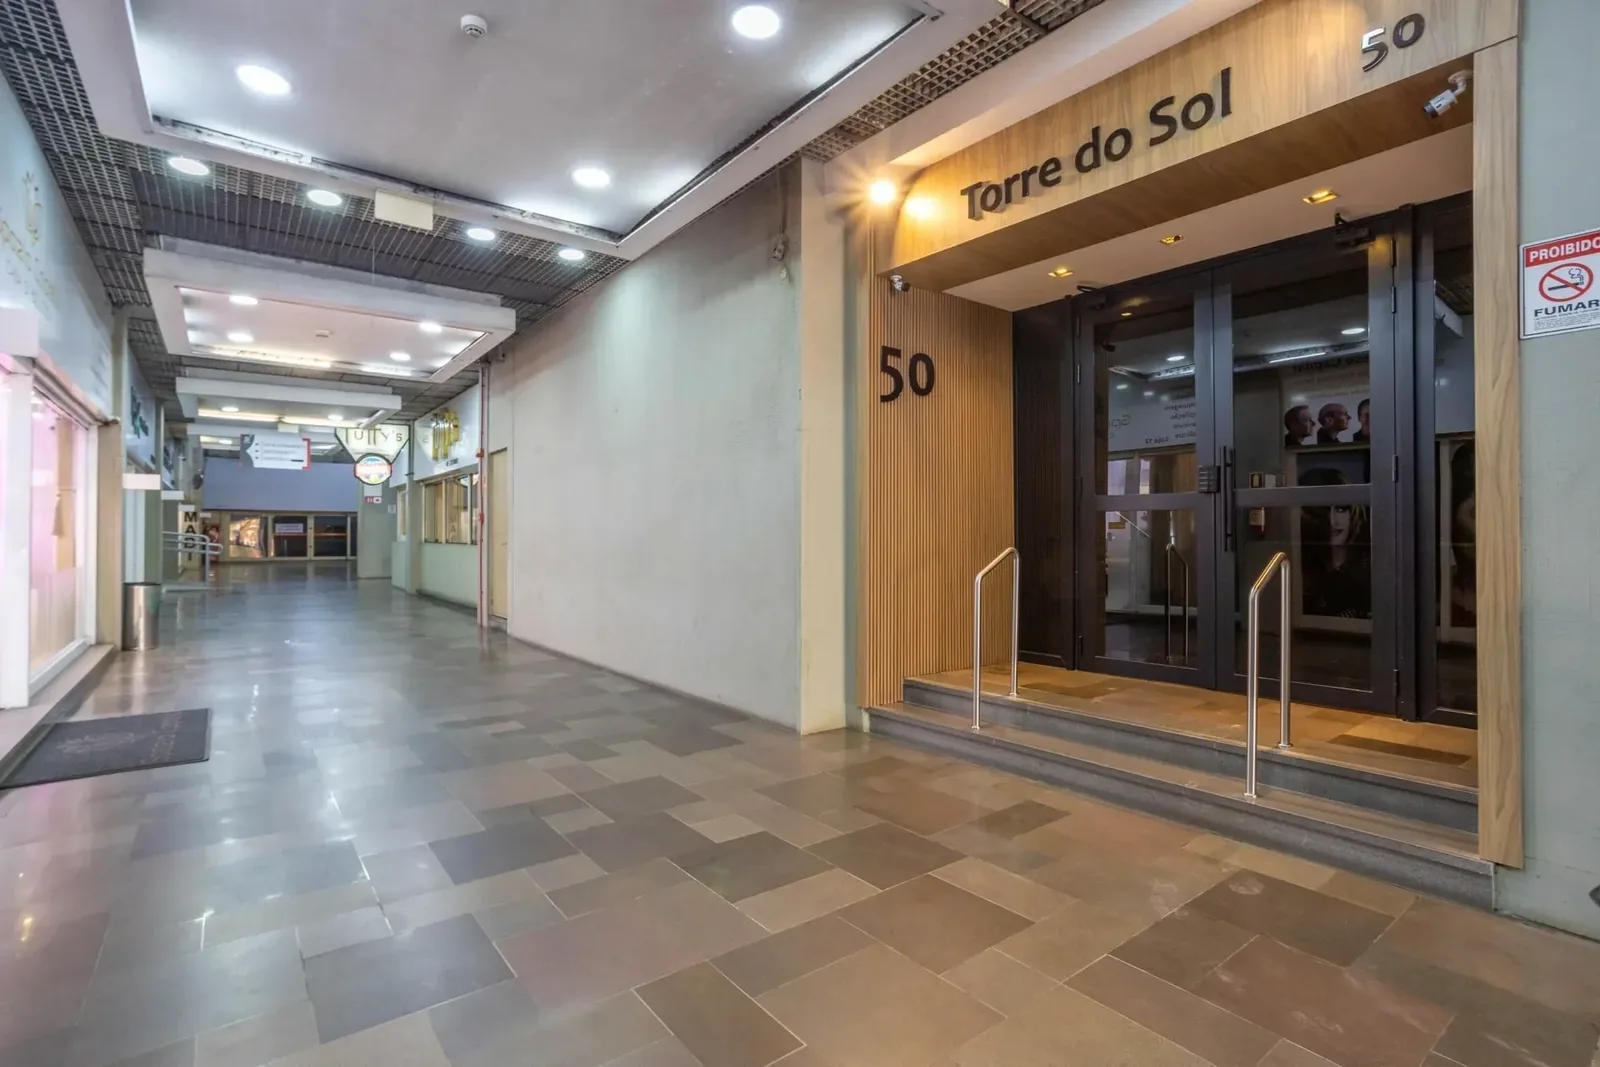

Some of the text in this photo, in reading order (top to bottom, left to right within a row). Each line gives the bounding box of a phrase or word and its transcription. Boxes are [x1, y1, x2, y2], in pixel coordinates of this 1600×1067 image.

[1361, 12, 1426, 73] 50
[960, 66, 1233, 221] Torre do Sol
[1529, 236, 1600, 263] PROIBIDO
[1534, 298, 1600, 318] FUMAR
[880, 345, 935, 403] 50
